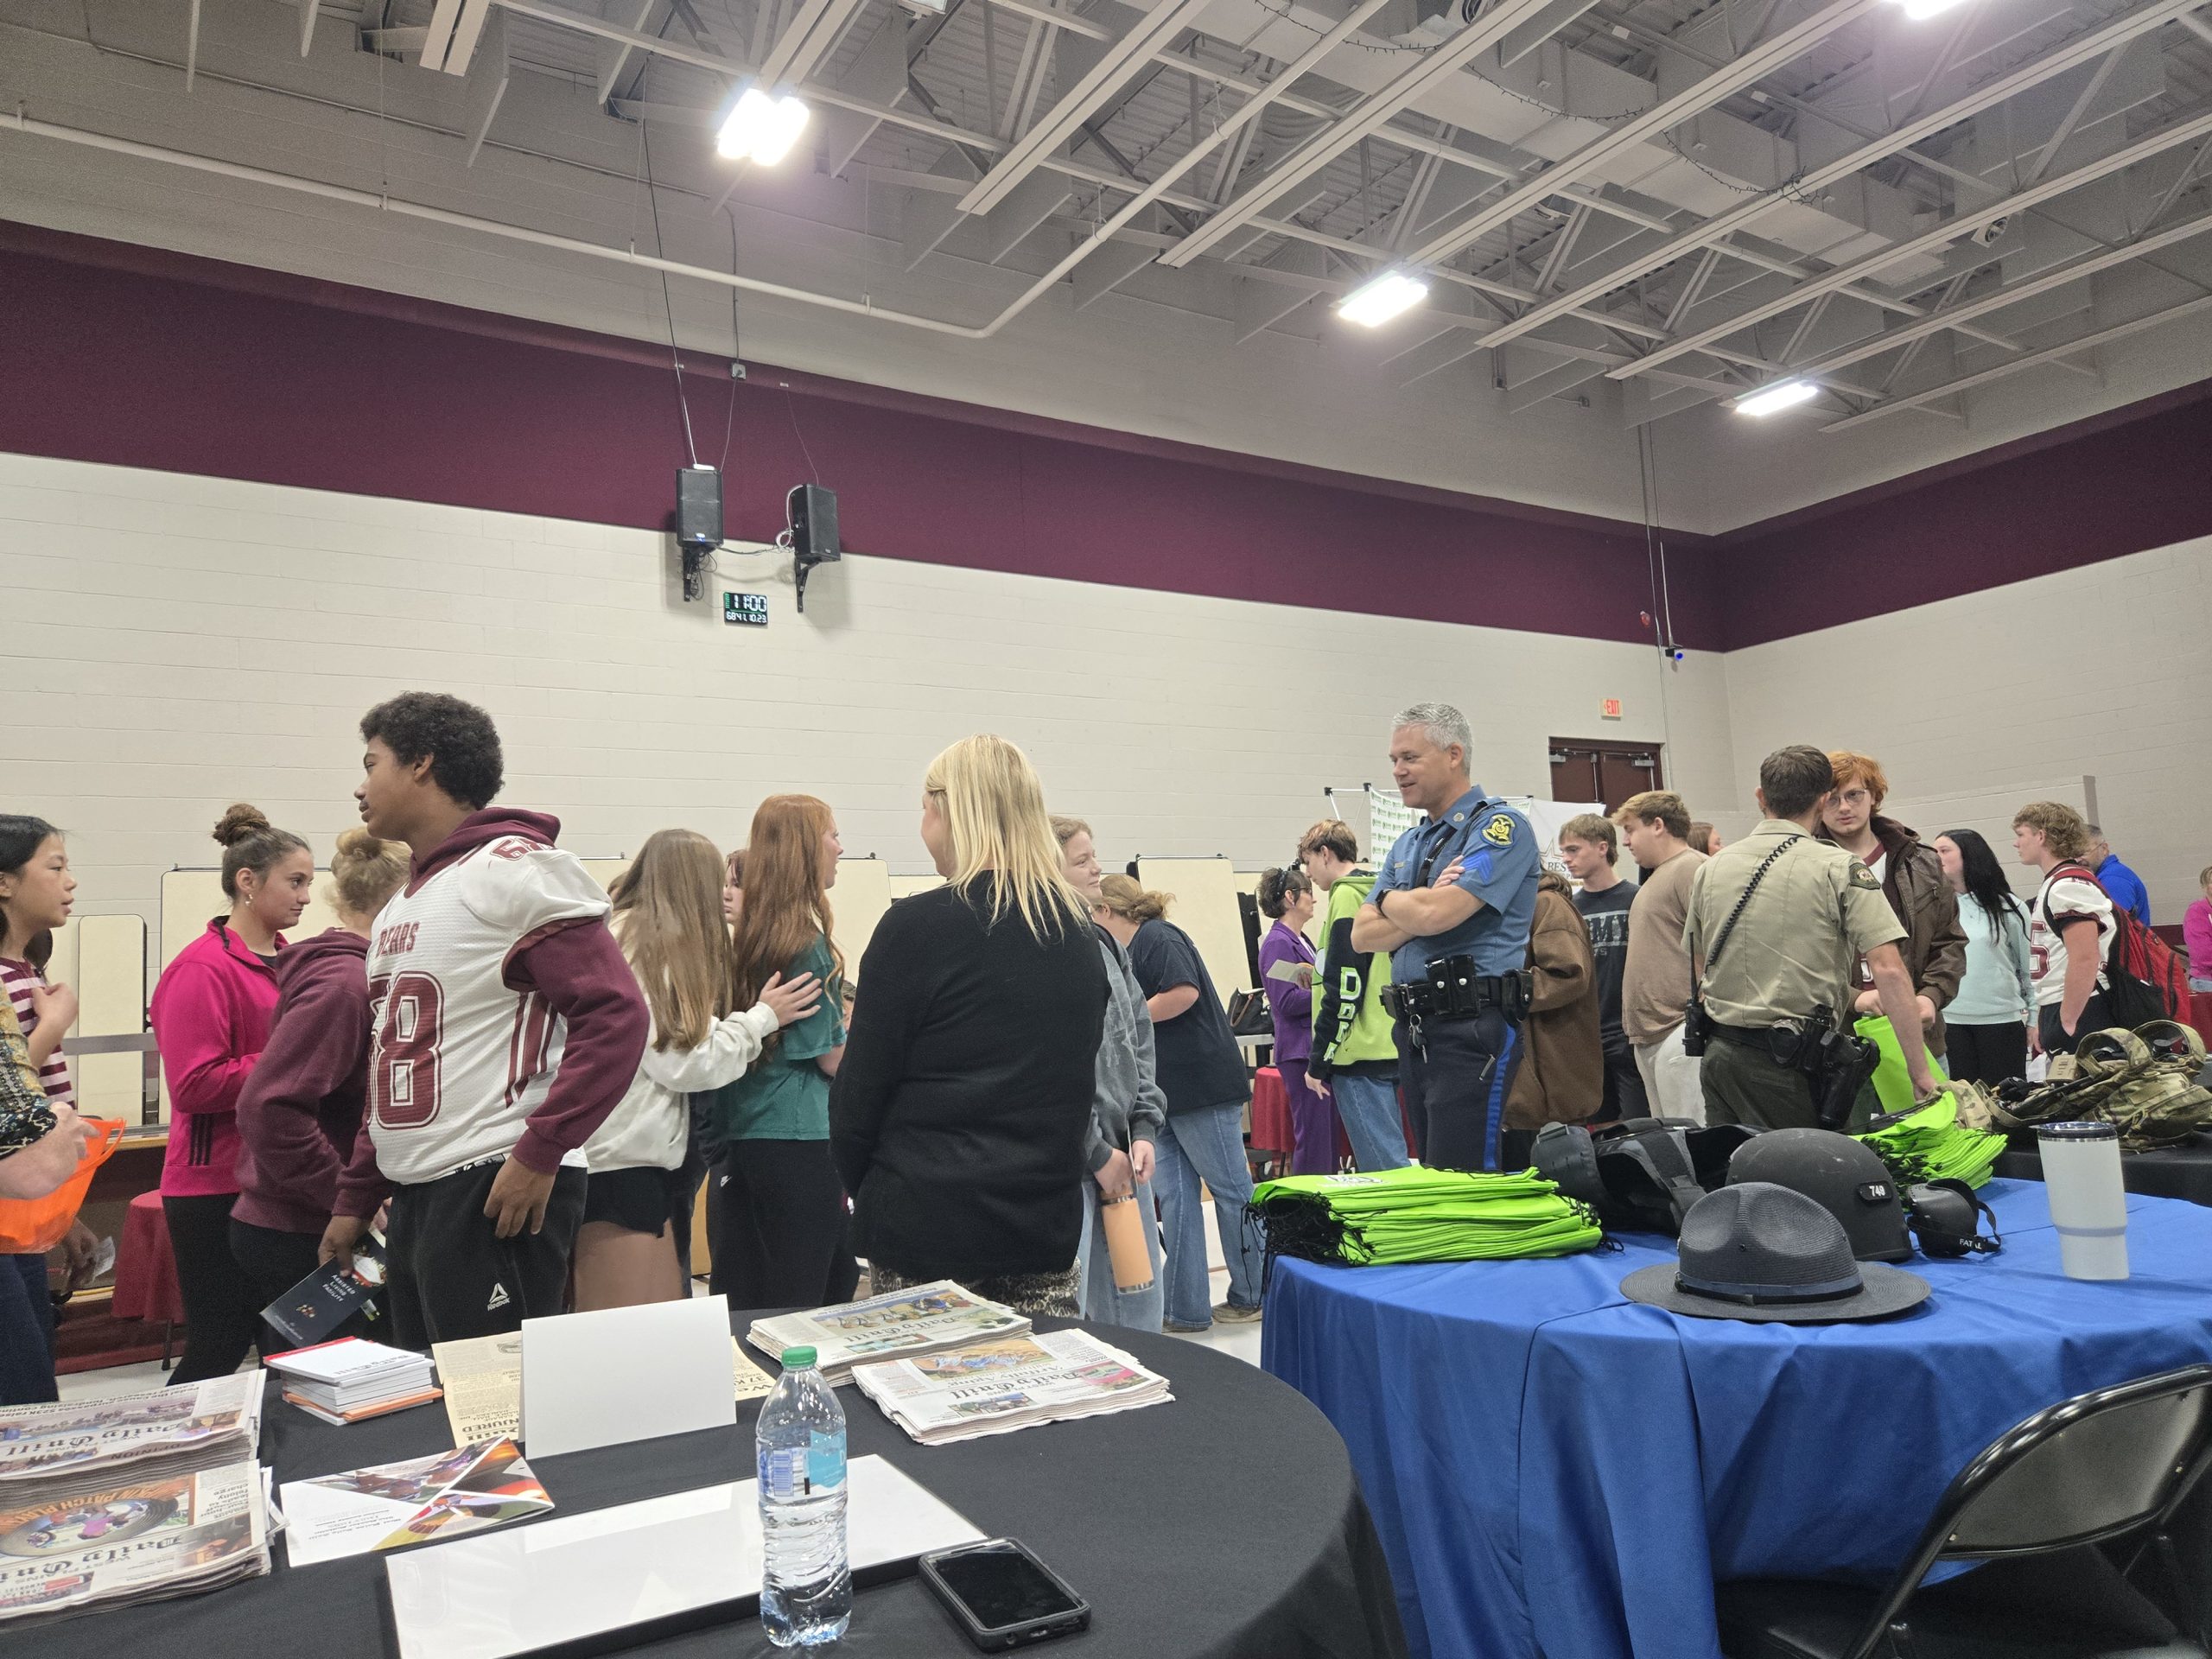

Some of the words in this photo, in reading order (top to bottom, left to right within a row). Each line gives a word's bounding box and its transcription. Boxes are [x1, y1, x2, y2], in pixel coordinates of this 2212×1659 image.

[734, 594, 767, 612] 11:00
[1606, 699, 1620, 715] EXIT
[377, 921, 420, 959] BEARS
[367, 970, 444, 1130] 8
[1869, 1185, 1885, 1197] 749
[1016, 1370, 1081, 1384] Daily
[950, 1383, 1014, 1399] Quill
[101, 1423, 181, 1440] Daily
[462, 1419, 518, 1433] NJURED
[467, 1427, 518, 1440] uill
[6, 1435, 94, 1456] Quill
[111, 1443, 180, 1459] OPINION
[60, 1492, 117, 1510] PATCH
[82, 1535, 181, 1563] Daily
[0, 1560, 72, 1583] Qui
